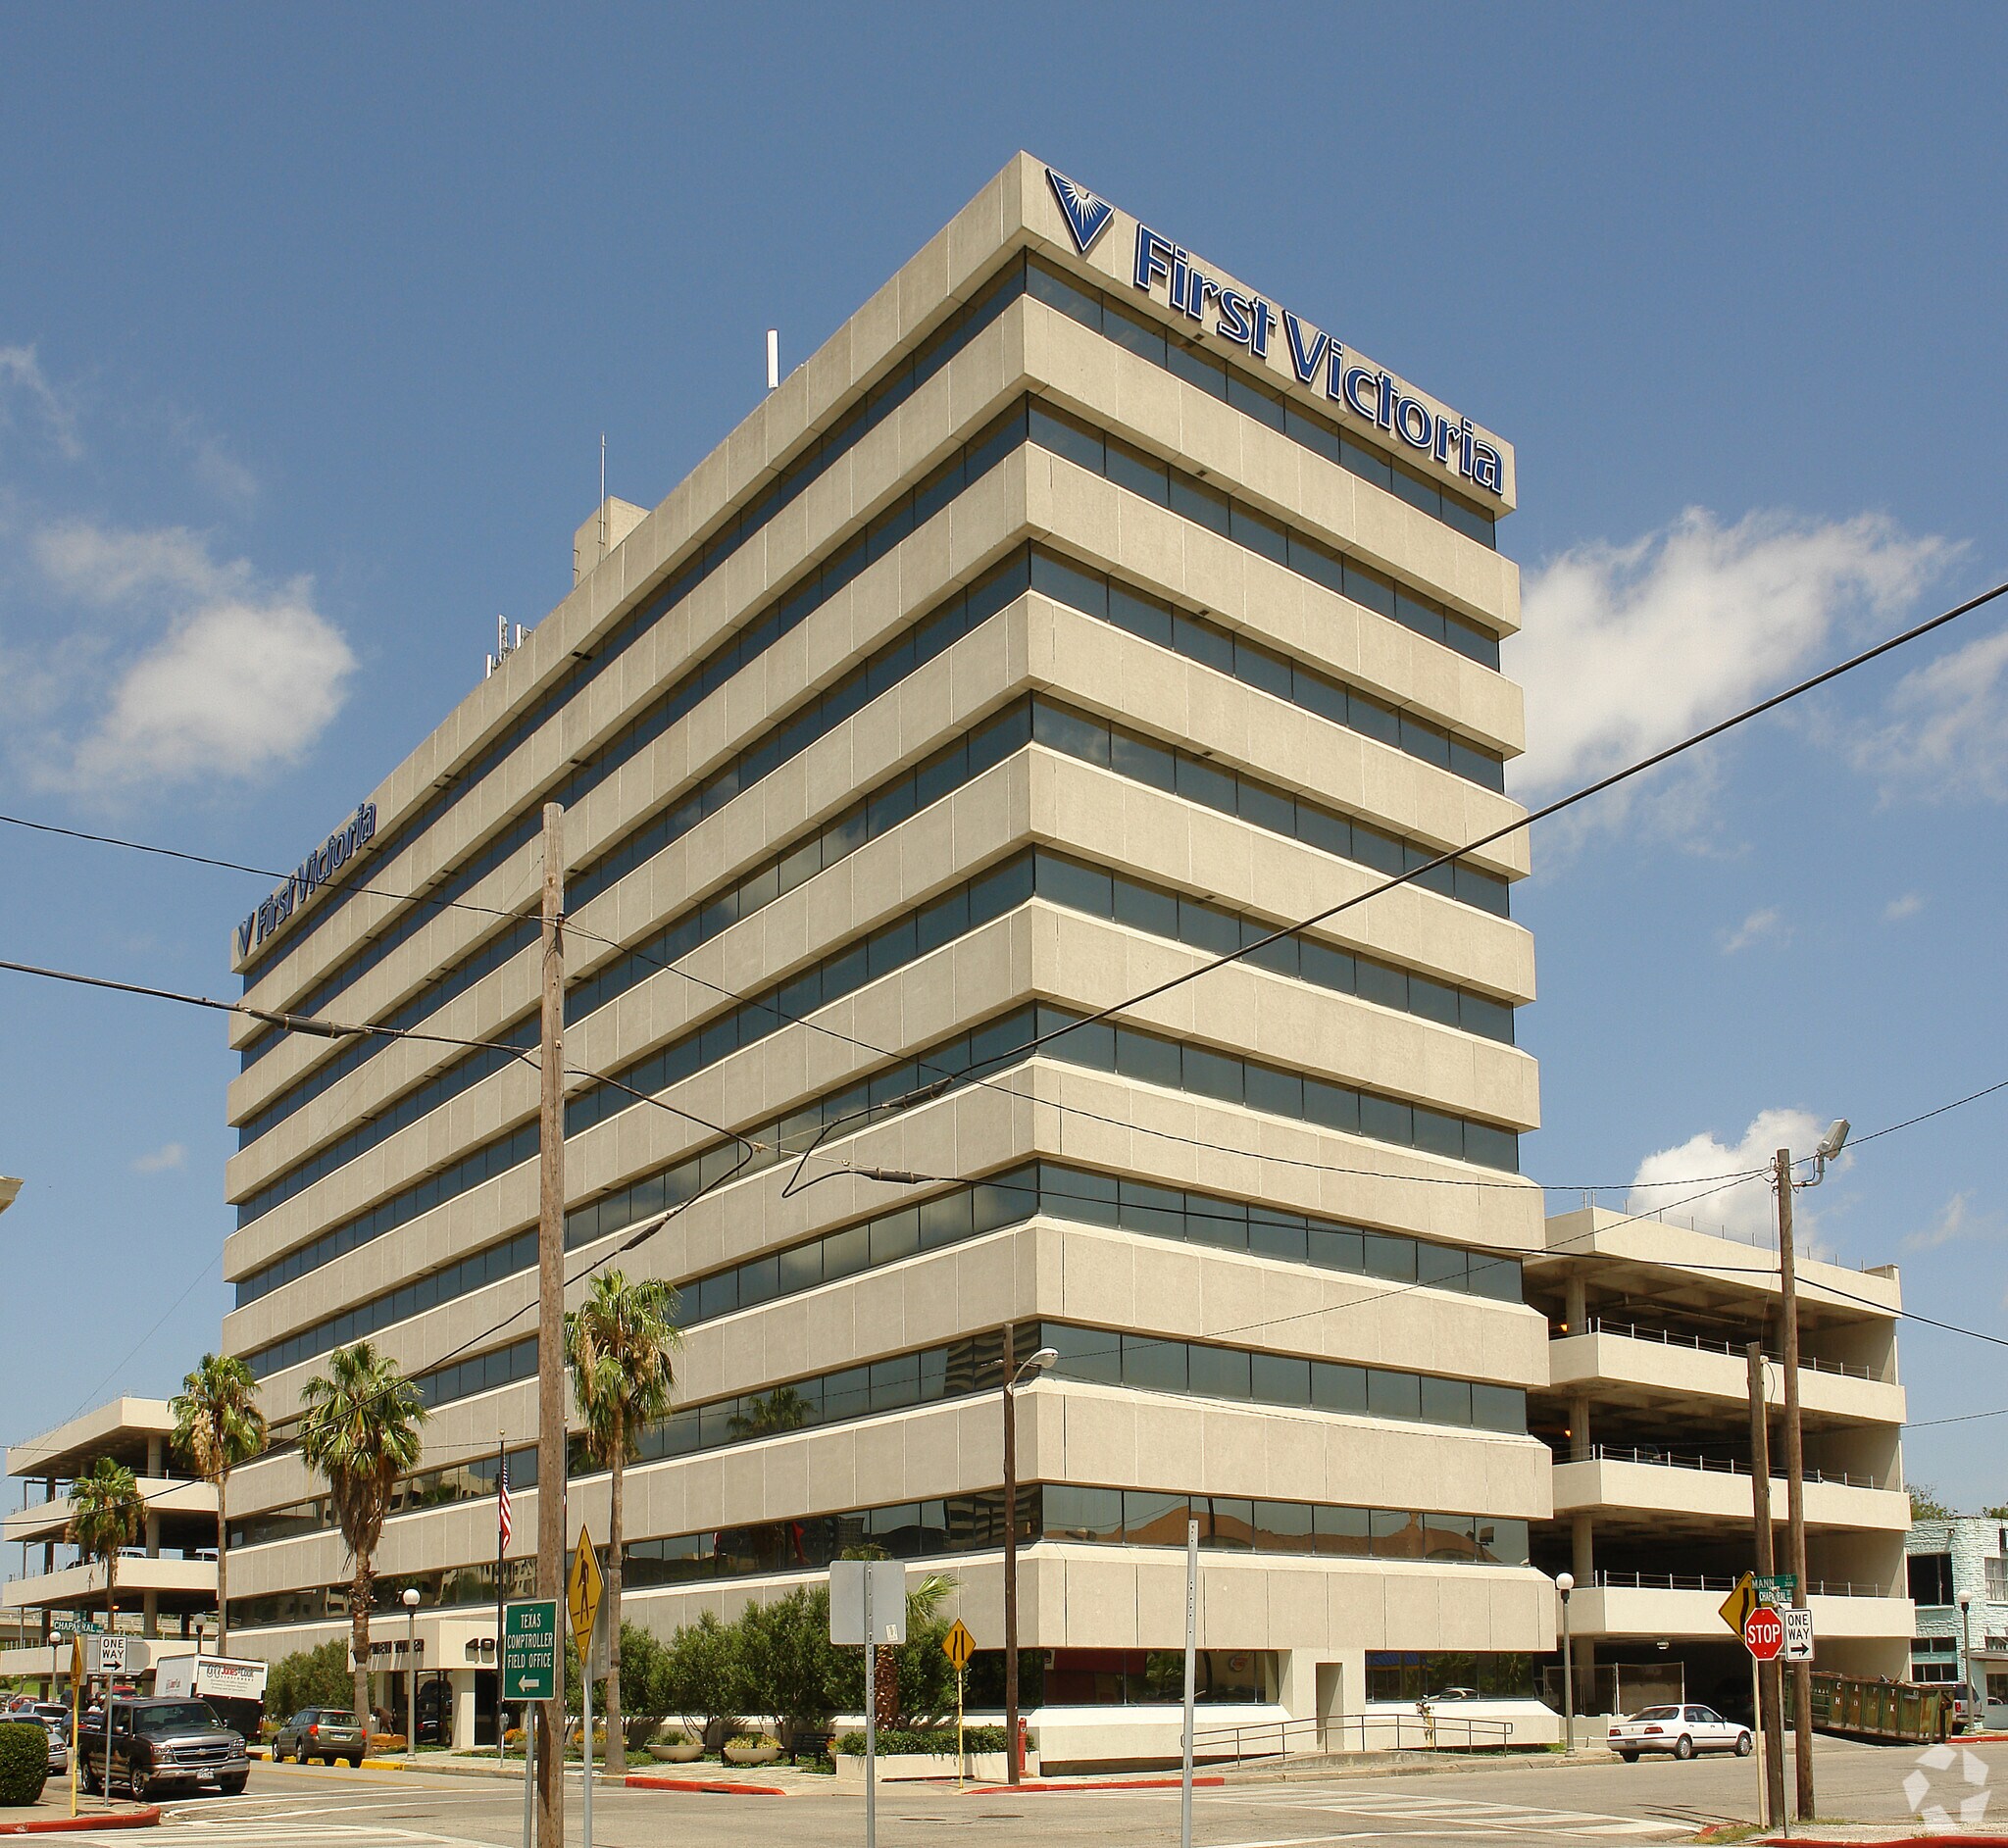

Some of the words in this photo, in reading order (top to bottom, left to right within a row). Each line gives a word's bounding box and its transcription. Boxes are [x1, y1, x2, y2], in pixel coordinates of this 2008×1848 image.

[1133, 223, 1278, 358] First
[1283, 309, 1505, 494] Victoria
[257, 874, 296, 945] First
[297, 803, 376, 904] Victoria
[1751, 1577, 1775, 1589] MANN
[54, 1621, 96, 1632] CHAPARAL
[521, 1613, 541, 1629] TEXAS
[1787, 1614, 1809, 1626] ONE
[507, 1632, 553, 1649] COMPTROLLER
[1747, 1623, 1781, 1644] STOP
[1788, 1628, 1810, 1640] WAY
[103, 1638, 124, 1649] ONE
[102, 1649, 125, 1659] WAY
[507, 1653, 526, 1669] FIELD
[528, 1652, 552, 1669] OFFICE
